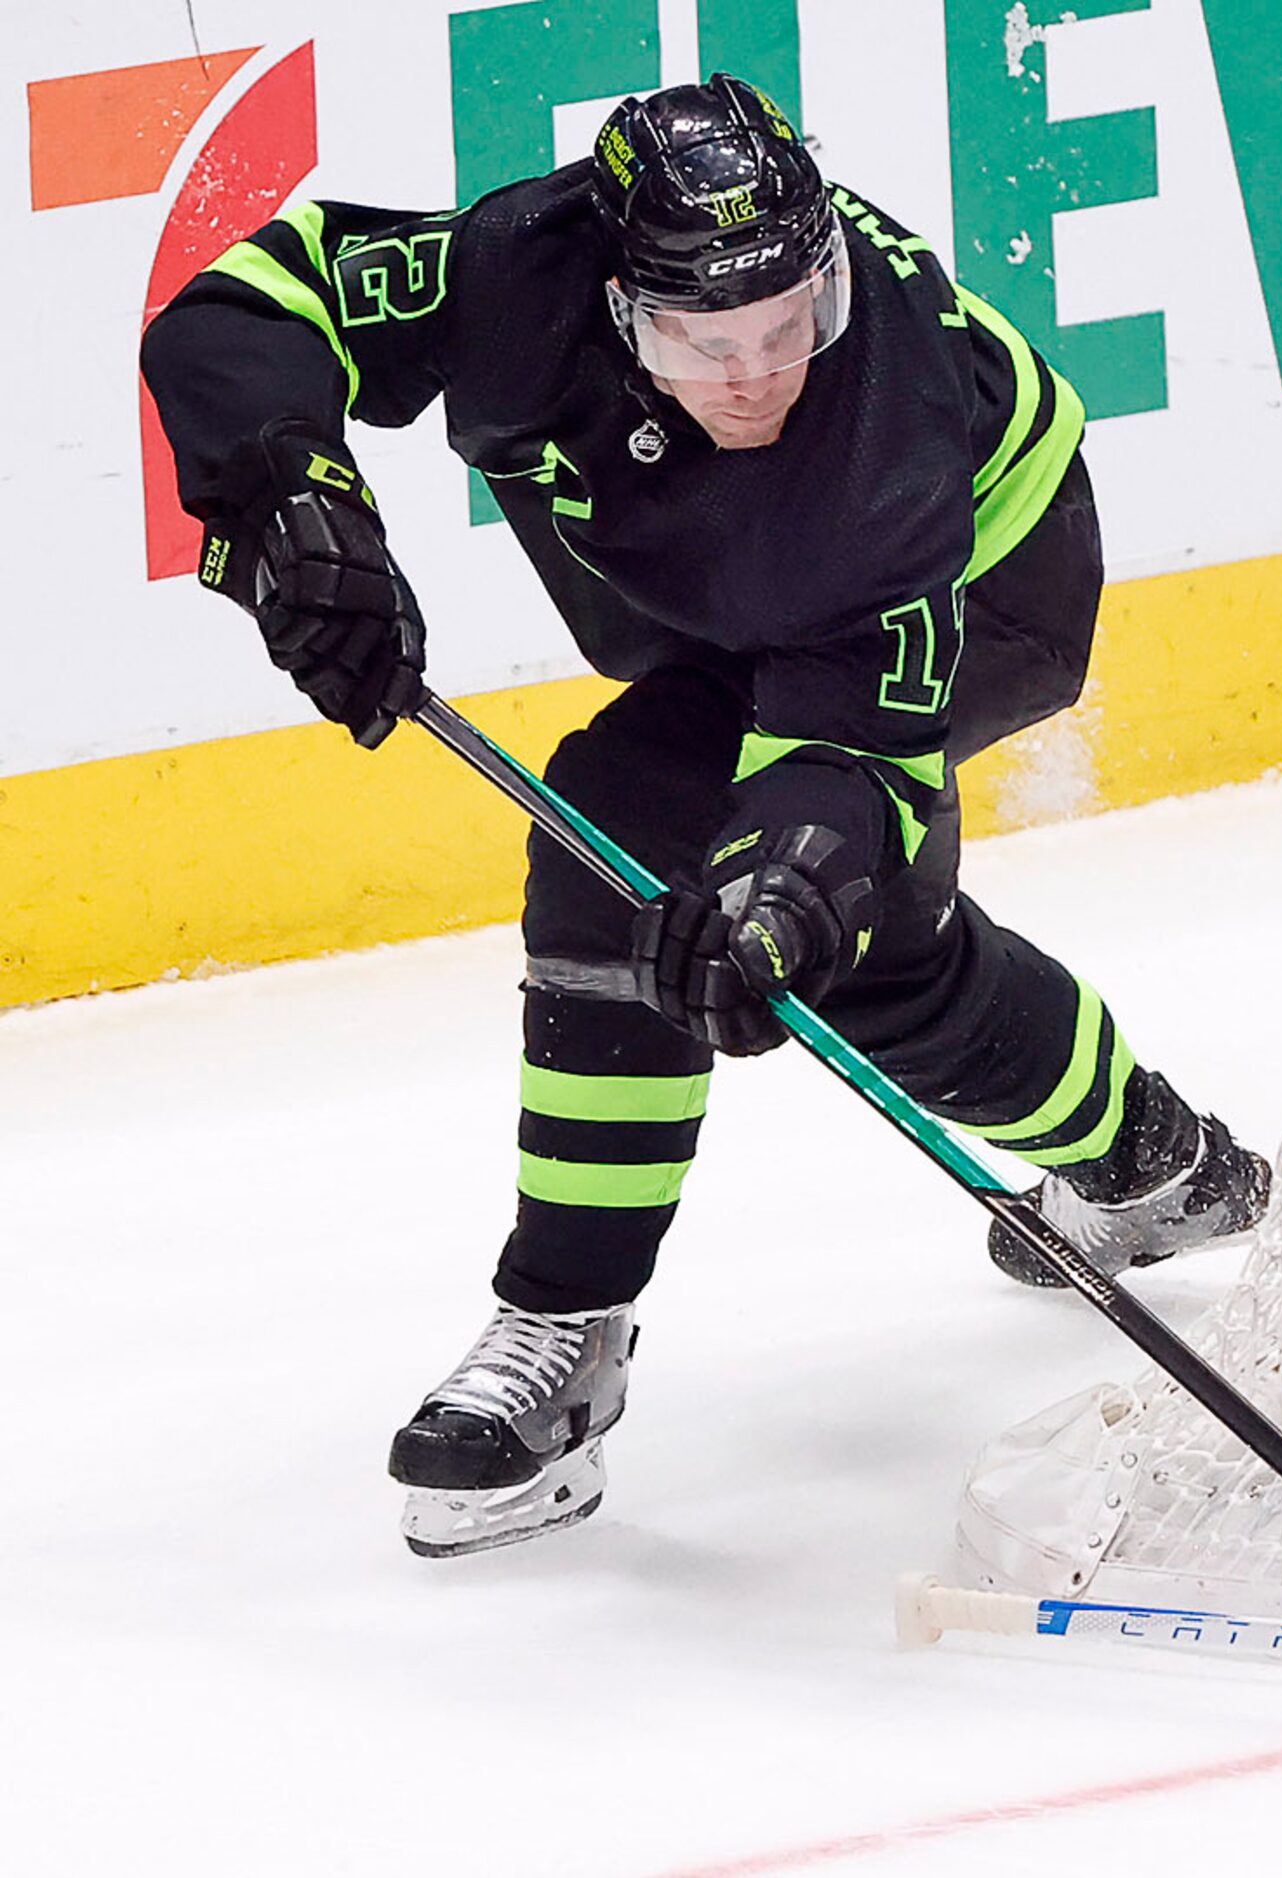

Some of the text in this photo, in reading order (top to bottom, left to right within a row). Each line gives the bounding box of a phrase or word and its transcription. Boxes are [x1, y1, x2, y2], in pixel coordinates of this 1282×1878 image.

[709, 185, 757, 227] 12
[708, 242, 784, 276] CCM
[201, 536, 222, 583] CCM
[745, 920, 786, 979] CCM
